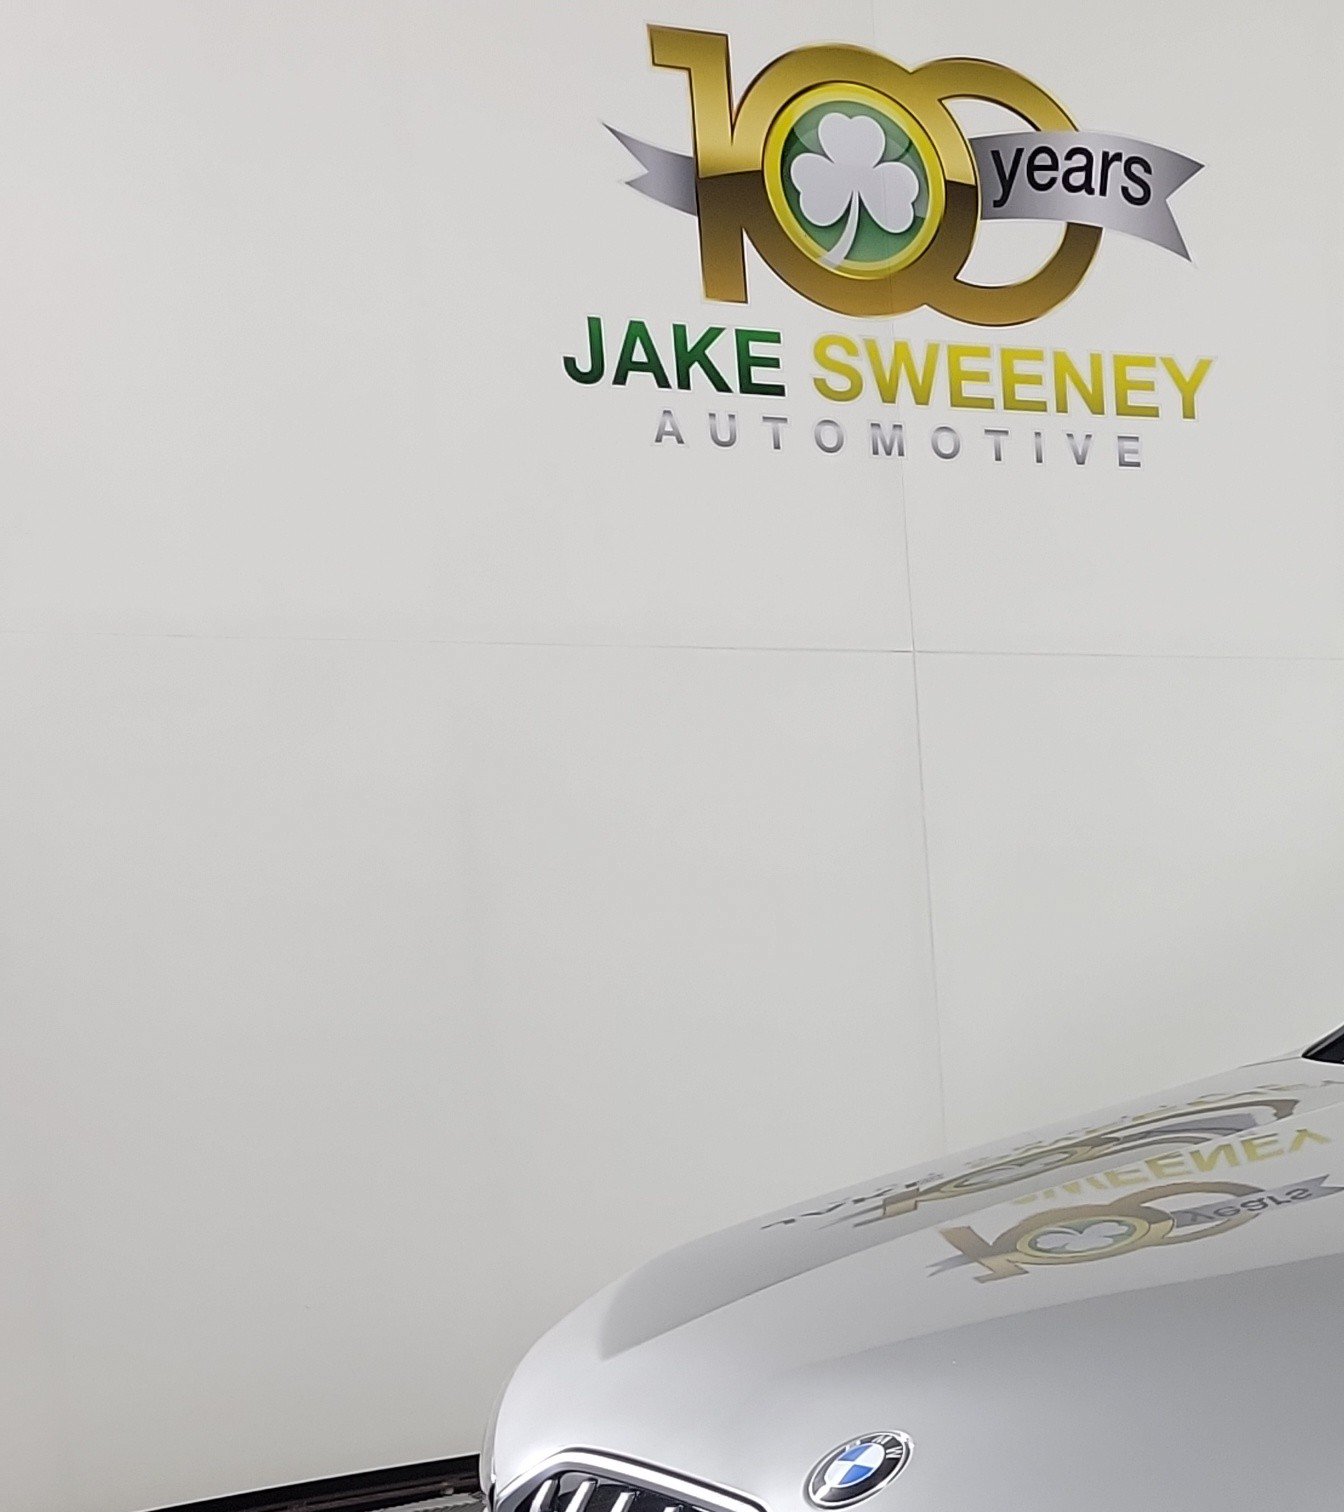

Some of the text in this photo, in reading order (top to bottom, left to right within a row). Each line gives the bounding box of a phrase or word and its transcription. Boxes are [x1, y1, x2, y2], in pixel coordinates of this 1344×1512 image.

[645, 23, 1154, 327] 100 years
[563, 317, 1213, 420] JAKE SWEENEY
[654, 409, 1142, 468] AUTOMOTIVE
